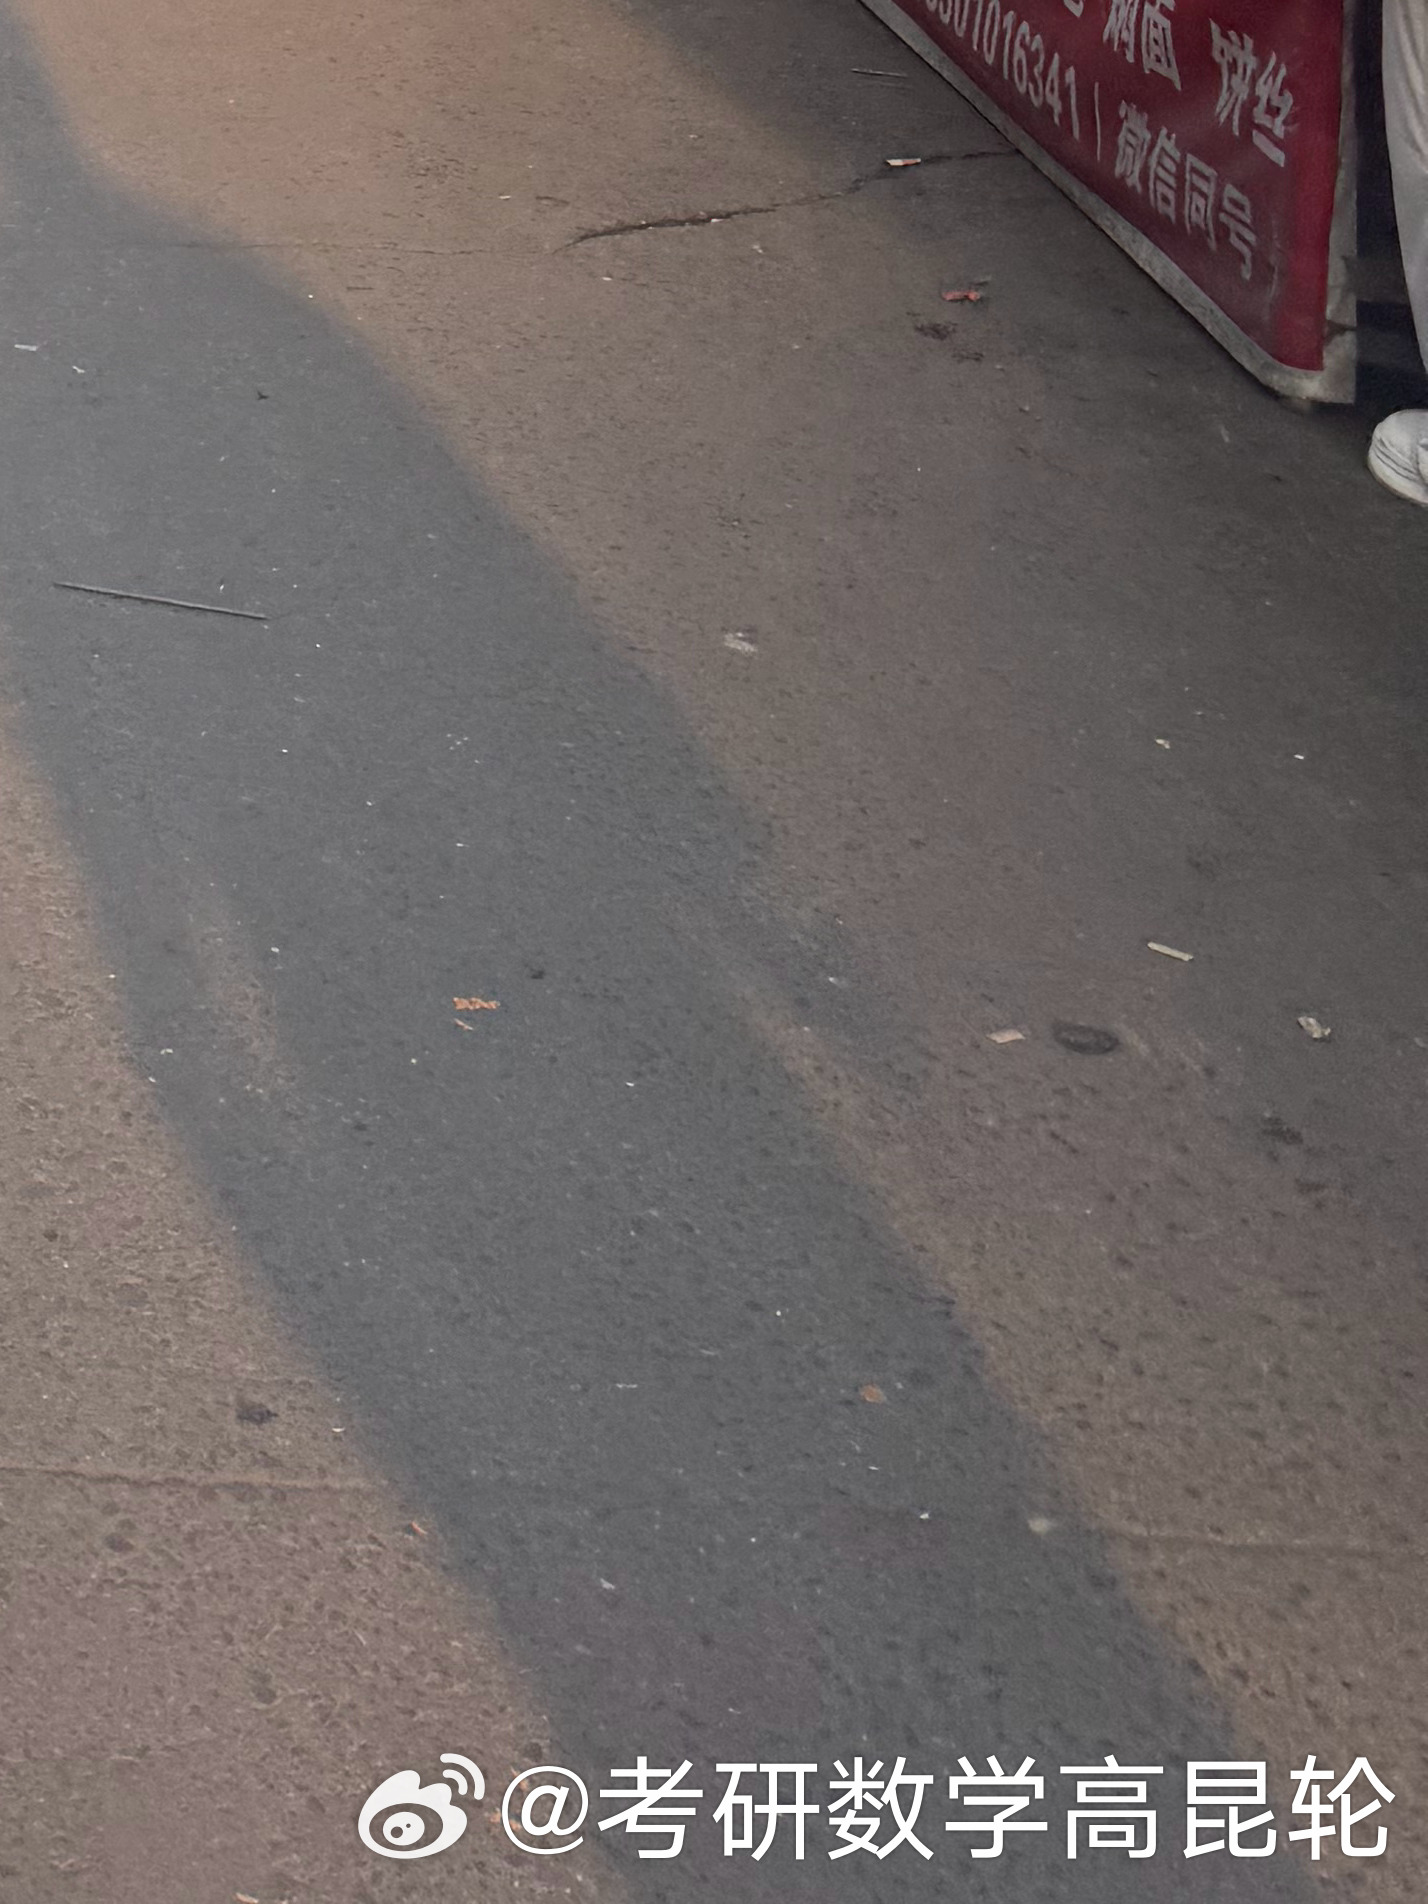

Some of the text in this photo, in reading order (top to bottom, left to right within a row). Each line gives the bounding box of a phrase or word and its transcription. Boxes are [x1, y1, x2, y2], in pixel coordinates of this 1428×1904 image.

[1210, 18, 1294, 168] 饼丝
[1114, 99, 1259, 282] 微信同号
